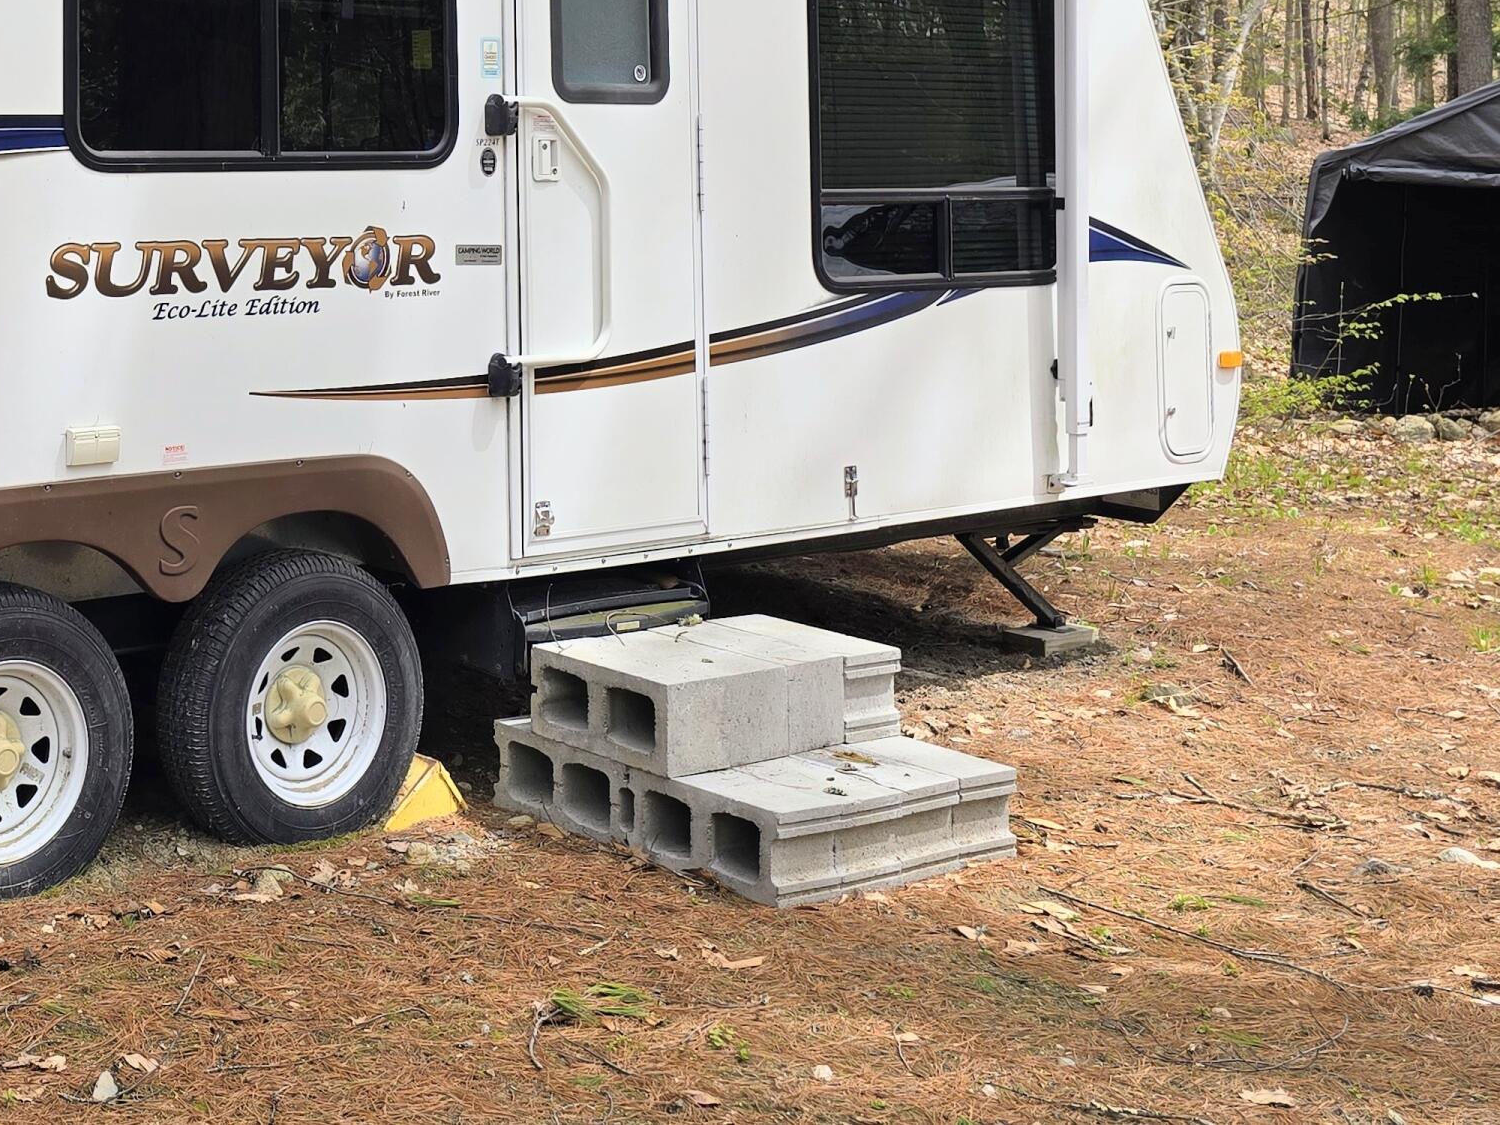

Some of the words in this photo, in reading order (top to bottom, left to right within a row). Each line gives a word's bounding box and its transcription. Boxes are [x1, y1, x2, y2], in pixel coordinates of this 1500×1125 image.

[46, 226, 441, 300] SURVEYOR
[482, 246, 500, 254] WORLD
[384, 290, 394, 299] By
[396, 289, 420, 297] Forest
[421, 288, 441, 297] River
[152, 298, 238, 321] Eco-Lite
[245, 295, 321, 316] Edition
[158, 505, 201, 577] S
